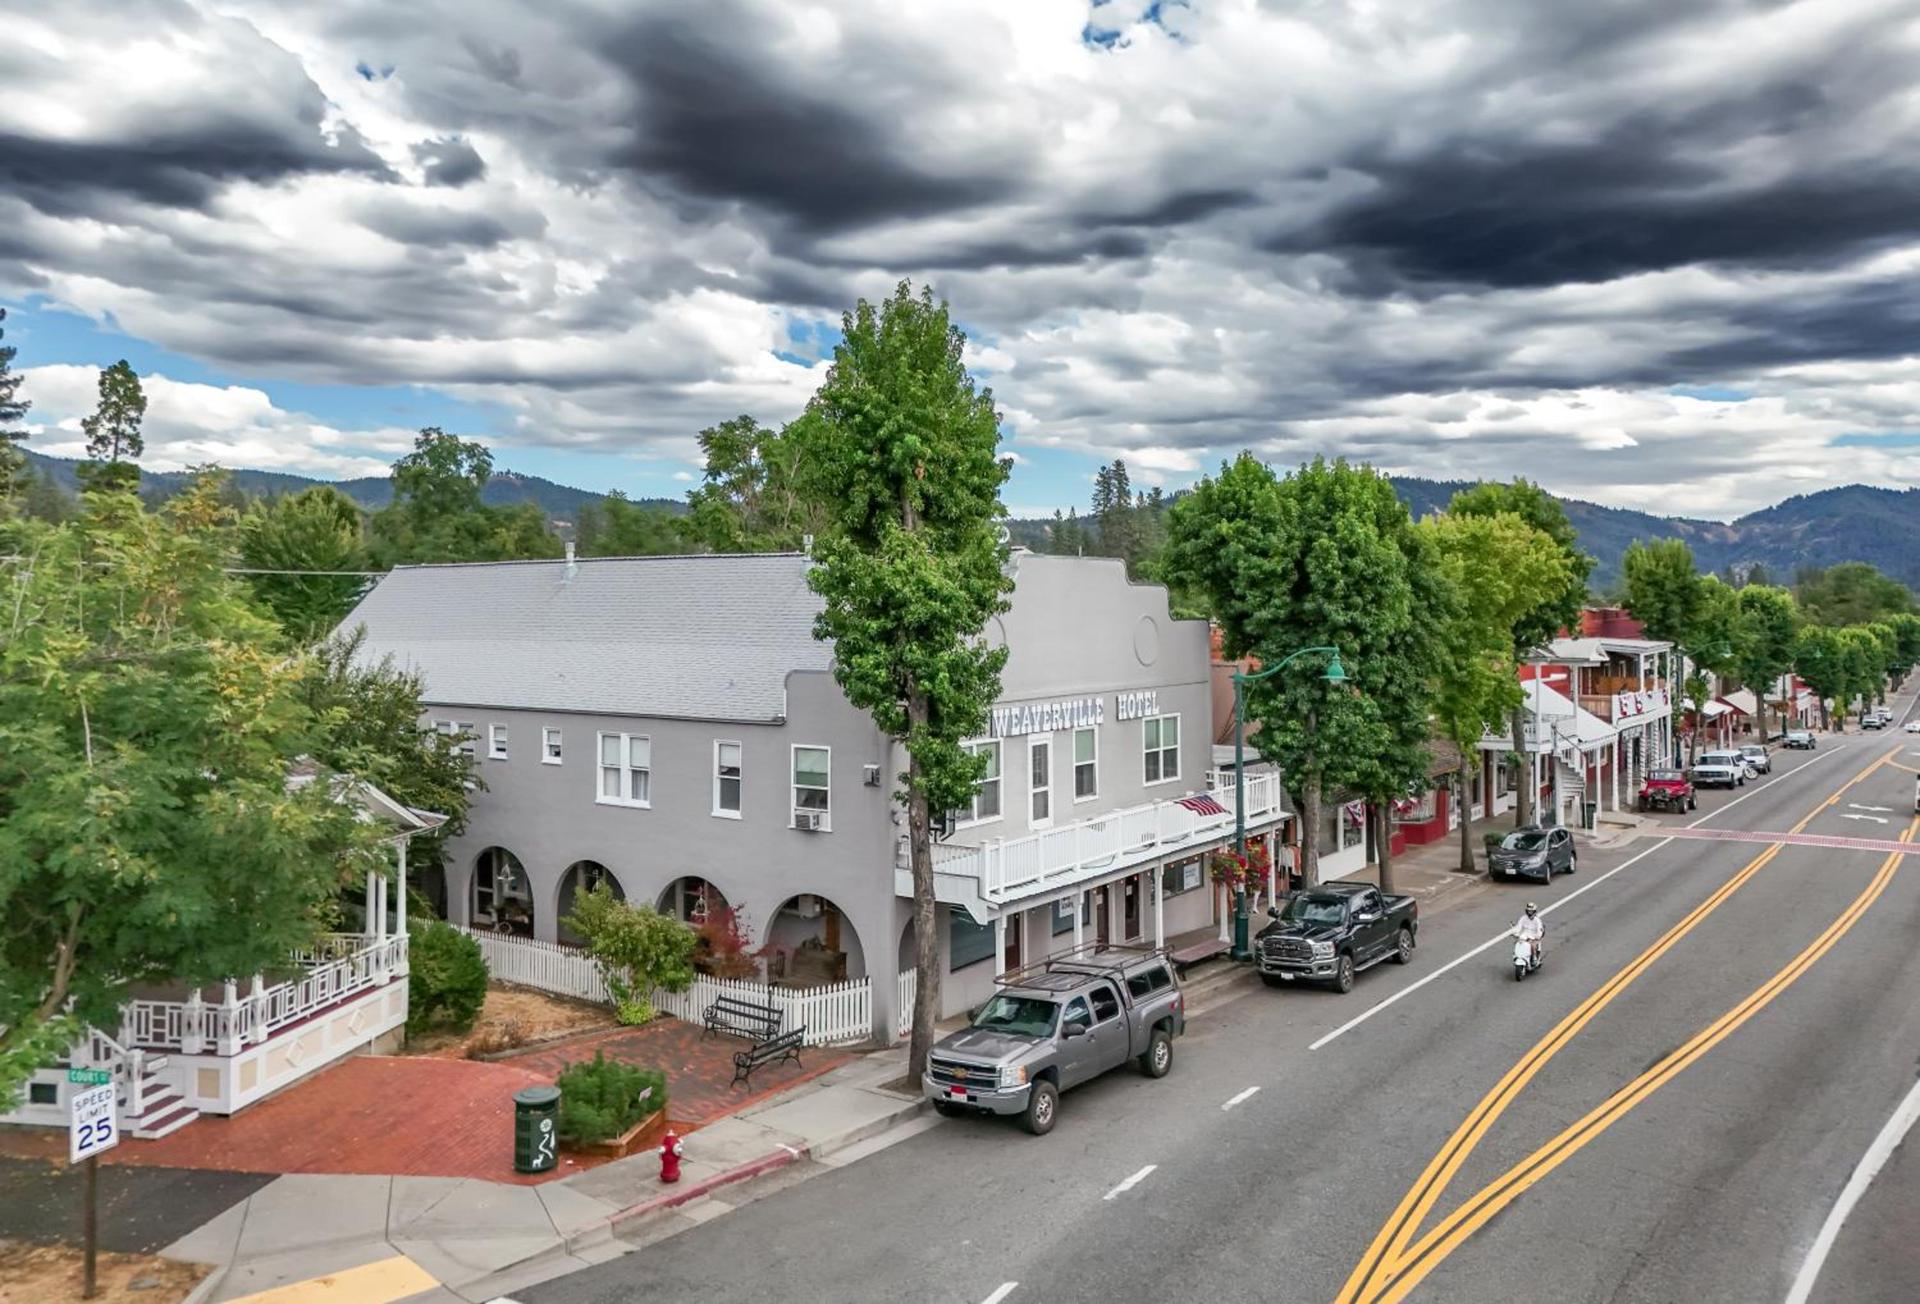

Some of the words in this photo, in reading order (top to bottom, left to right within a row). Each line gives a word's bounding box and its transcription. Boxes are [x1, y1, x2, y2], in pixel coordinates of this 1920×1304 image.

[993, 698, 1104, 737] WEAVERVILLE
[1117, 691, 1160, 720] HOTEL
[75, 1089, 113, 1112] SPEED
[79, 1104, 108, 1124] LIMIT
[78, 1117, 112, 1151] 25
